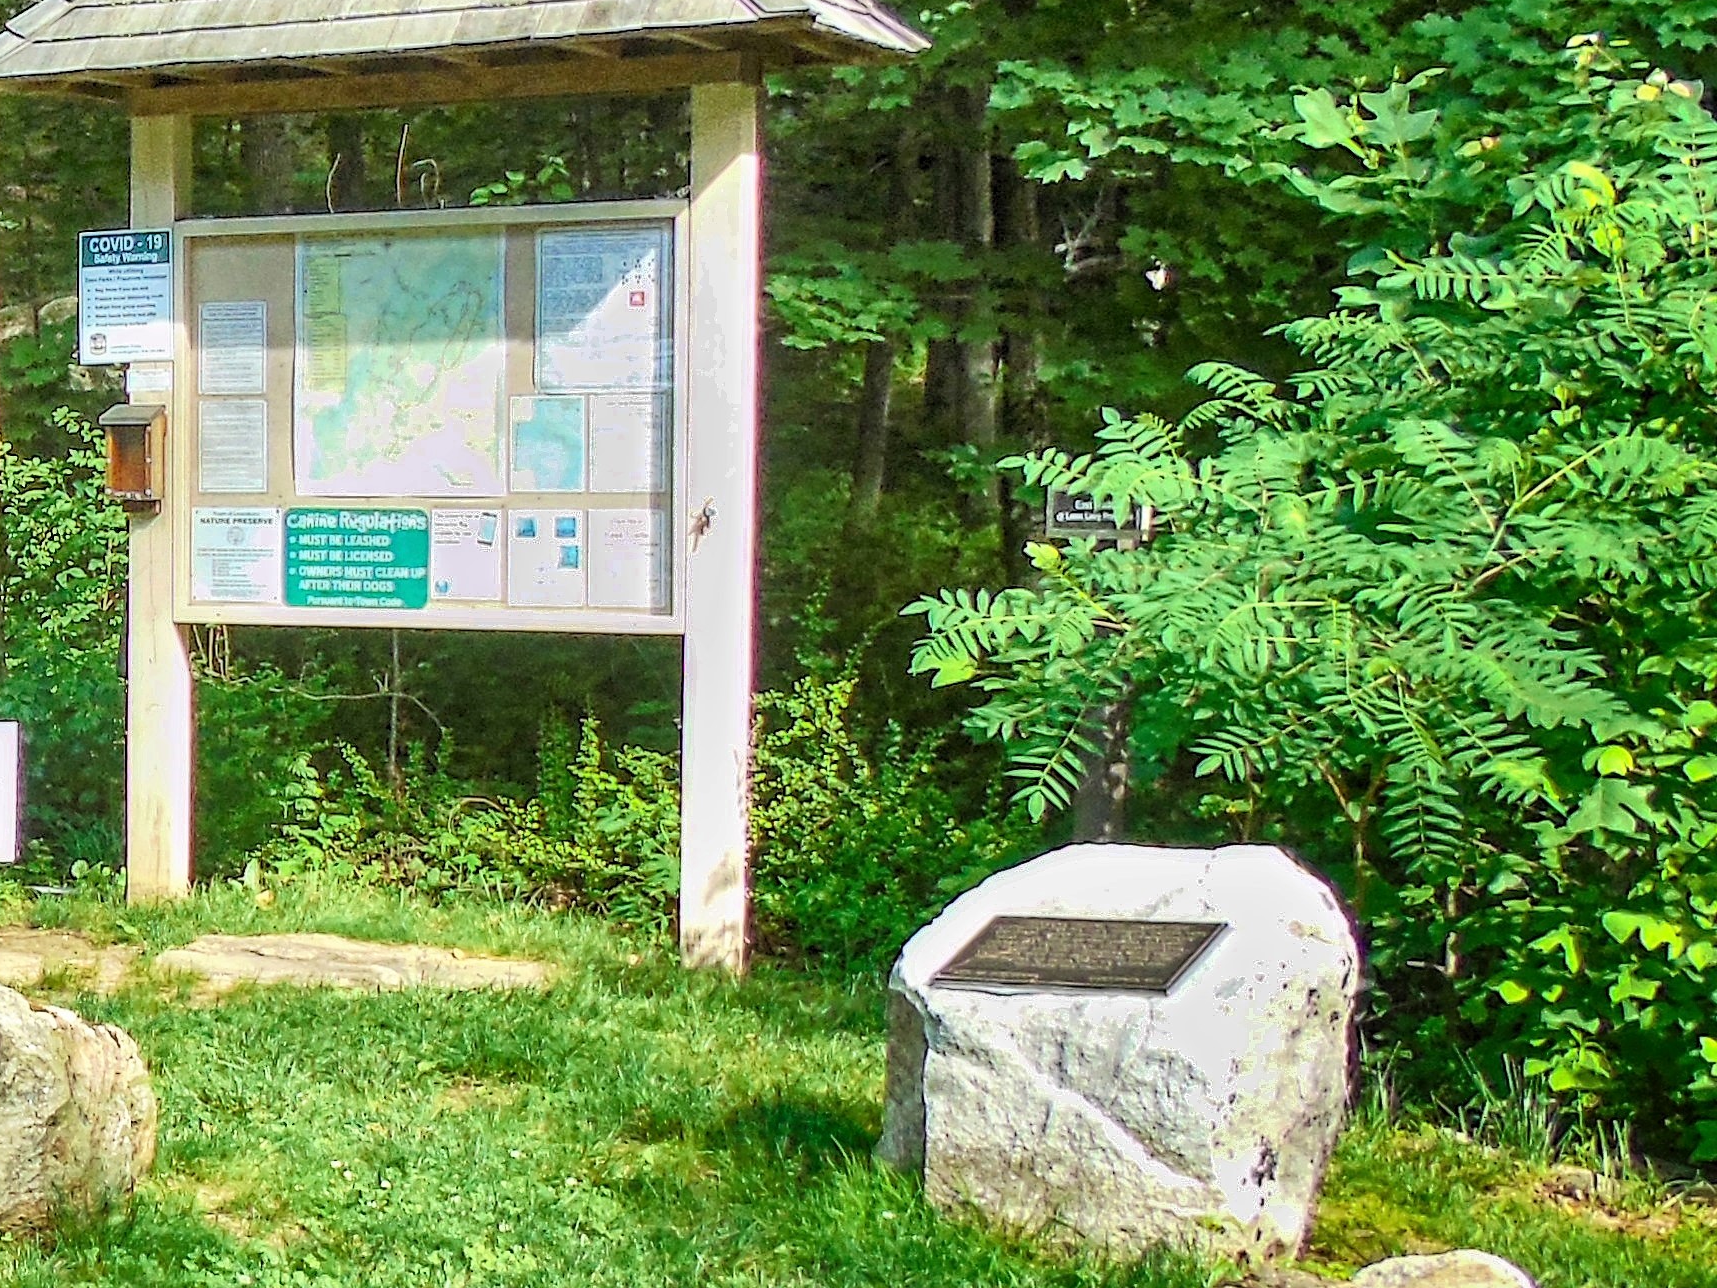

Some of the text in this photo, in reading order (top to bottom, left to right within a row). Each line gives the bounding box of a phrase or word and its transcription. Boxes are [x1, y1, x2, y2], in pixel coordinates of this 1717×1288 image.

[89, 235, 134, 253] COVID
[146, 234, 163, 250] 19
[93, 251, 158, 265] Safety Warning
[286, 513, 339, 529] Canine
[339, 511, 428, 533] Regulations
[298, 534, 392, 547] MUST BE LEASHED
[298, 550, 395, 562] MUST BE LICENSED
[298, 566, 427, 579] OWNERS MUST CLEAN UP
[298, 579, 396, 593] AFTER THEIR DOGS
